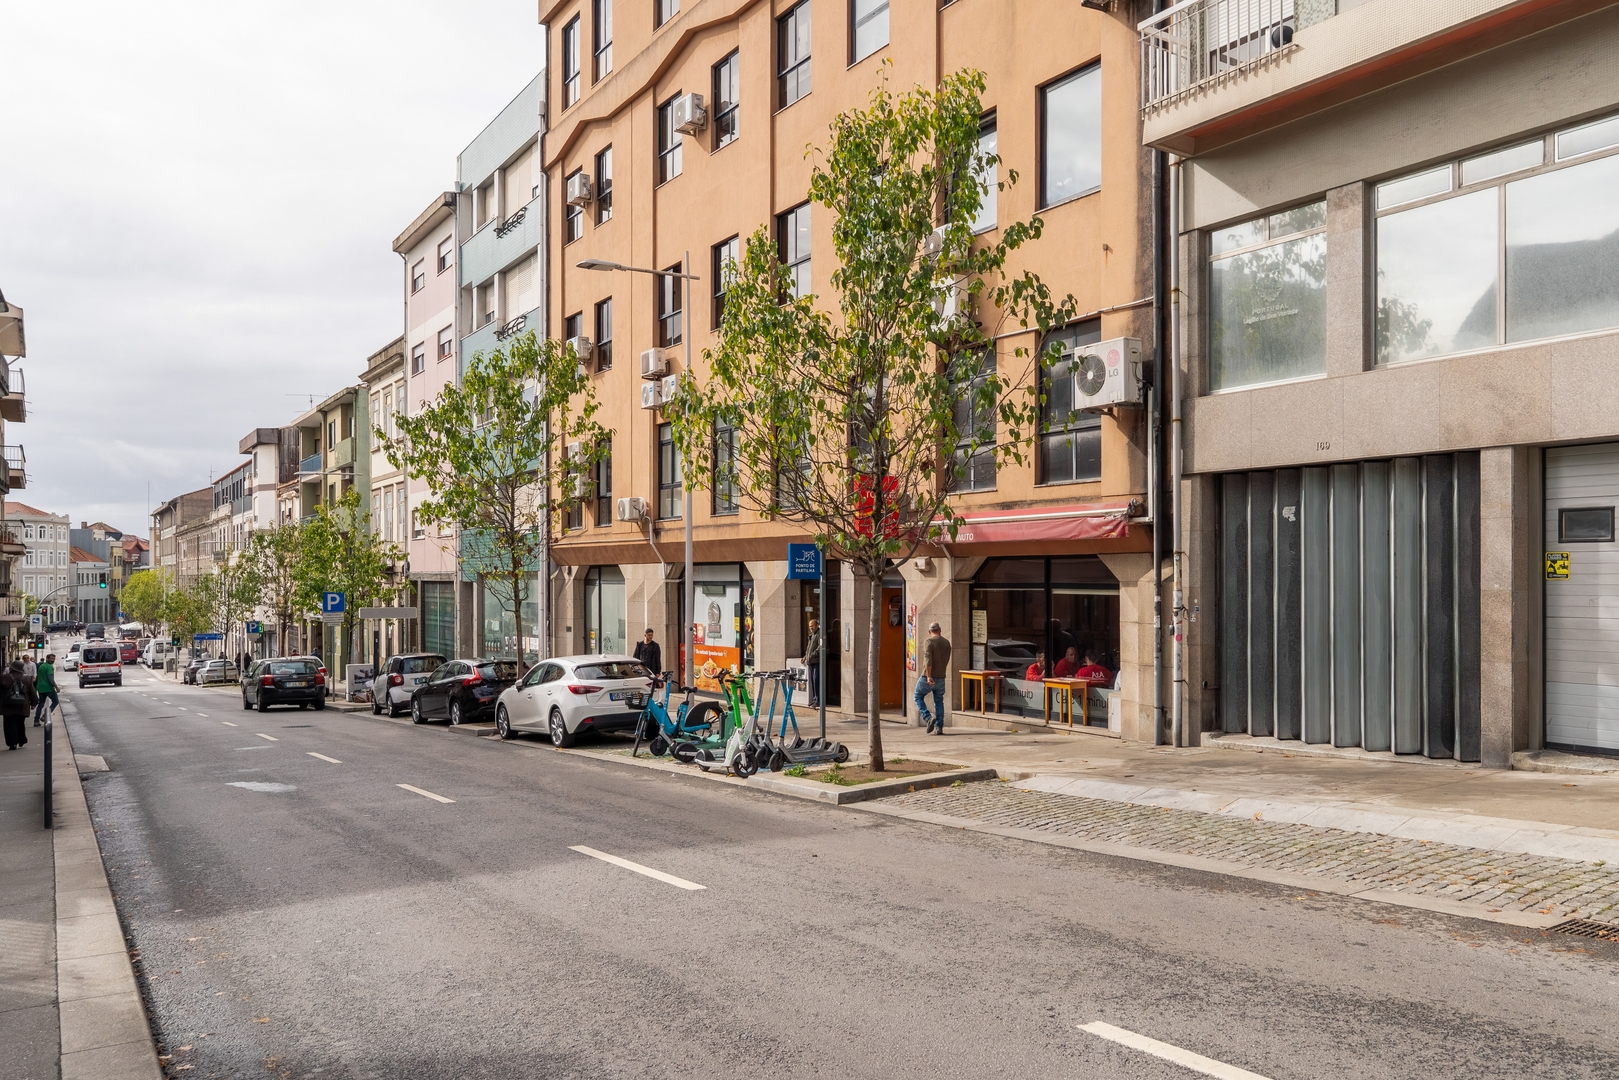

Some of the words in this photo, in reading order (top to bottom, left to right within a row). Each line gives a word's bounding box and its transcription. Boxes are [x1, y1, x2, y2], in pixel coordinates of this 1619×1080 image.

[1252, 303, 1289, 315] PORTUGAL
[1108, 369, 1118, 378] LG
[327, 594, 340, 610] P
[250, 623, 257, 633] P
